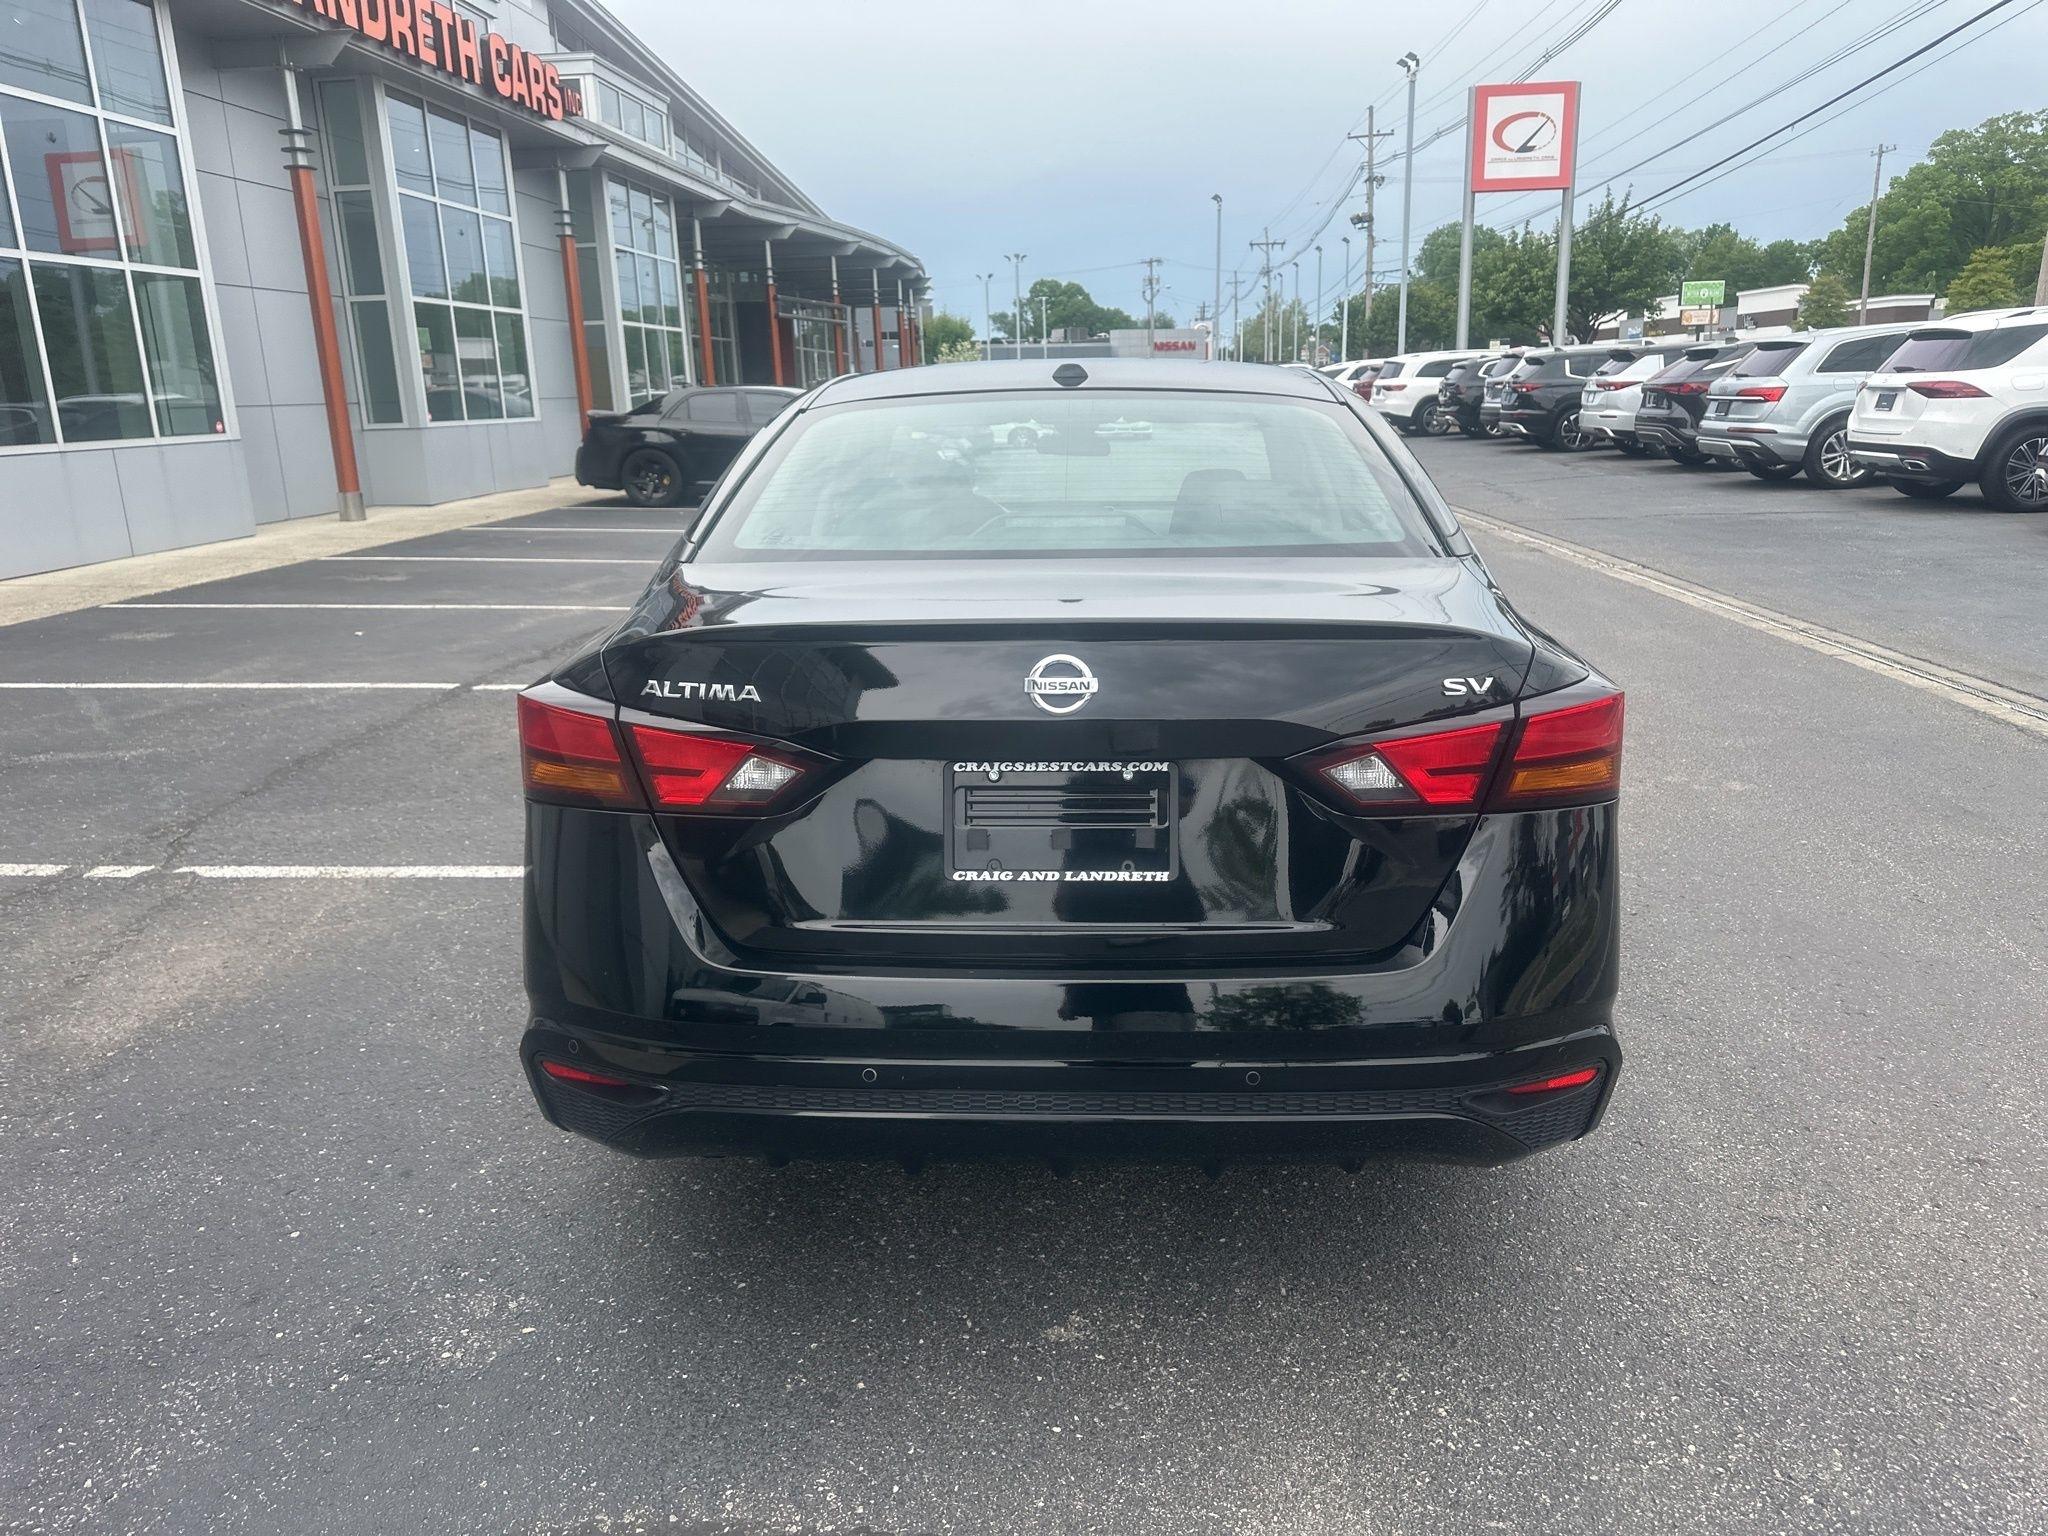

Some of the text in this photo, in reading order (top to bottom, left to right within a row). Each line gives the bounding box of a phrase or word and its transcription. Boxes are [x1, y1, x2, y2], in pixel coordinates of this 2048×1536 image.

[490, 32, 563, 121] CARS
[1153, 340, 1197, 352] NISSAN
[640, 679, 762, 703] ALTIMA
[1031, 681, 1090, 691] NISSAN
[1443, 677, 1494, 696] SV
[953, 761, 1170, 773] CRAIGSBESTCARS.COM
[952, 870, 1170, 882] CRAIG AND LANDRETH
